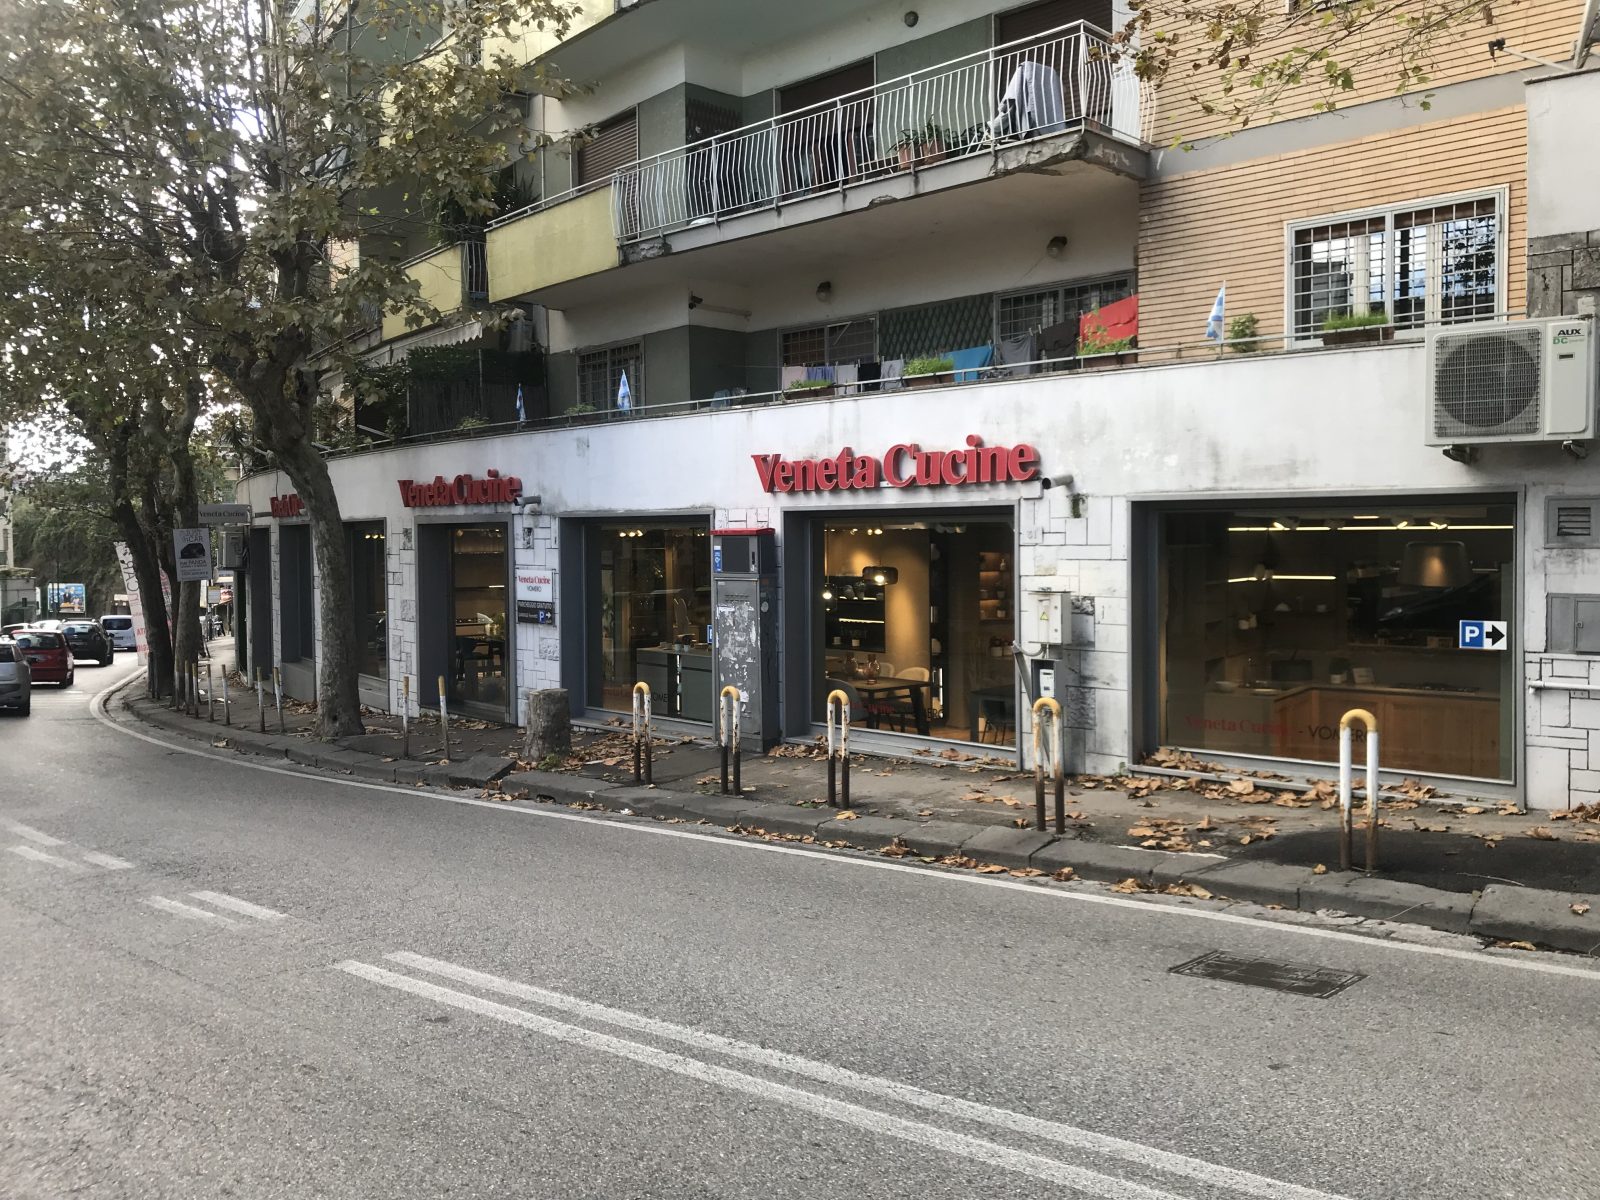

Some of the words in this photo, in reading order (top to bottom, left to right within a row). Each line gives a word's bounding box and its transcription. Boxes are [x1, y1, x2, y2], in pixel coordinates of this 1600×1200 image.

[1557, 328, 1581, 336] AUX
[751, 446, 880, 493] Veneta
[883, 434, 1040, 488] Cucine
[397, 476, 451, 507] Veneta
[453, 469, 522, 505] Cucine
[518, 575, 534, 584] Veneta
[535, 575, 551, 585] Cucine
[539, 611, 545, 622] P
[1465, 626, 1480, 642] P
